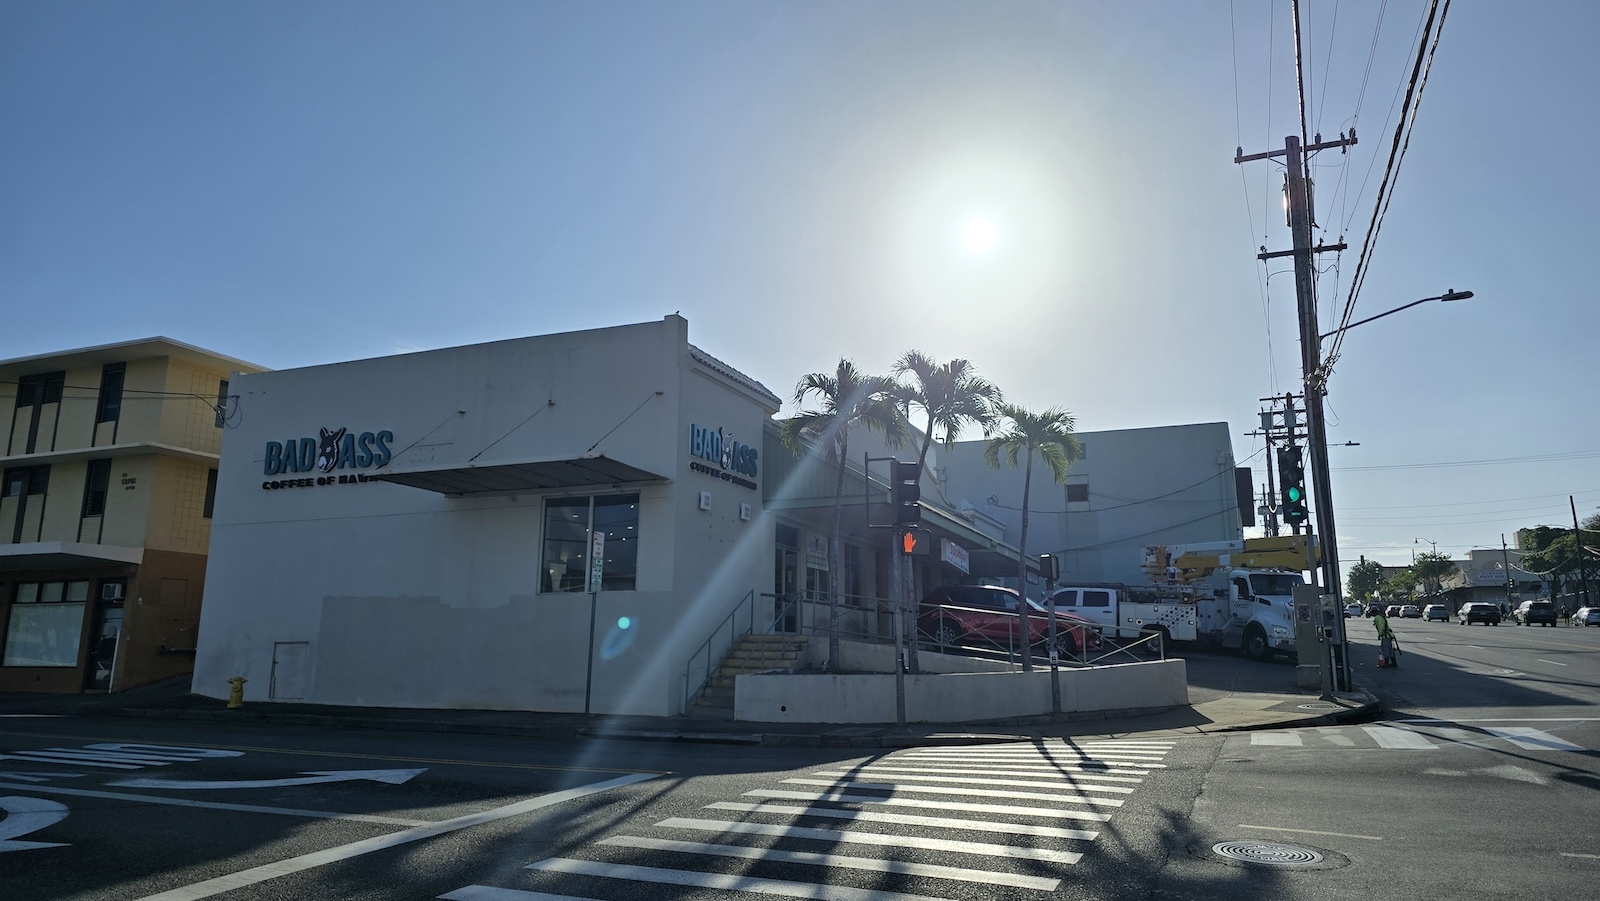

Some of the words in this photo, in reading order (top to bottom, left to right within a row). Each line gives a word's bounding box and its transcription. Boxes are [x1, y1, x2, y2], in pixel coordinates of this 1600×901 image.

[263, 437, 316, 476] BAD
[336, 430, 394, 470] ASS
[690, 423, 721, 463] BAD
[730, 441, 758, 478] ASS
[262, 477, 315, 490] COFFEE
[316, 475, 336, 486] OF
[338, 473, 379, 484] HAW
